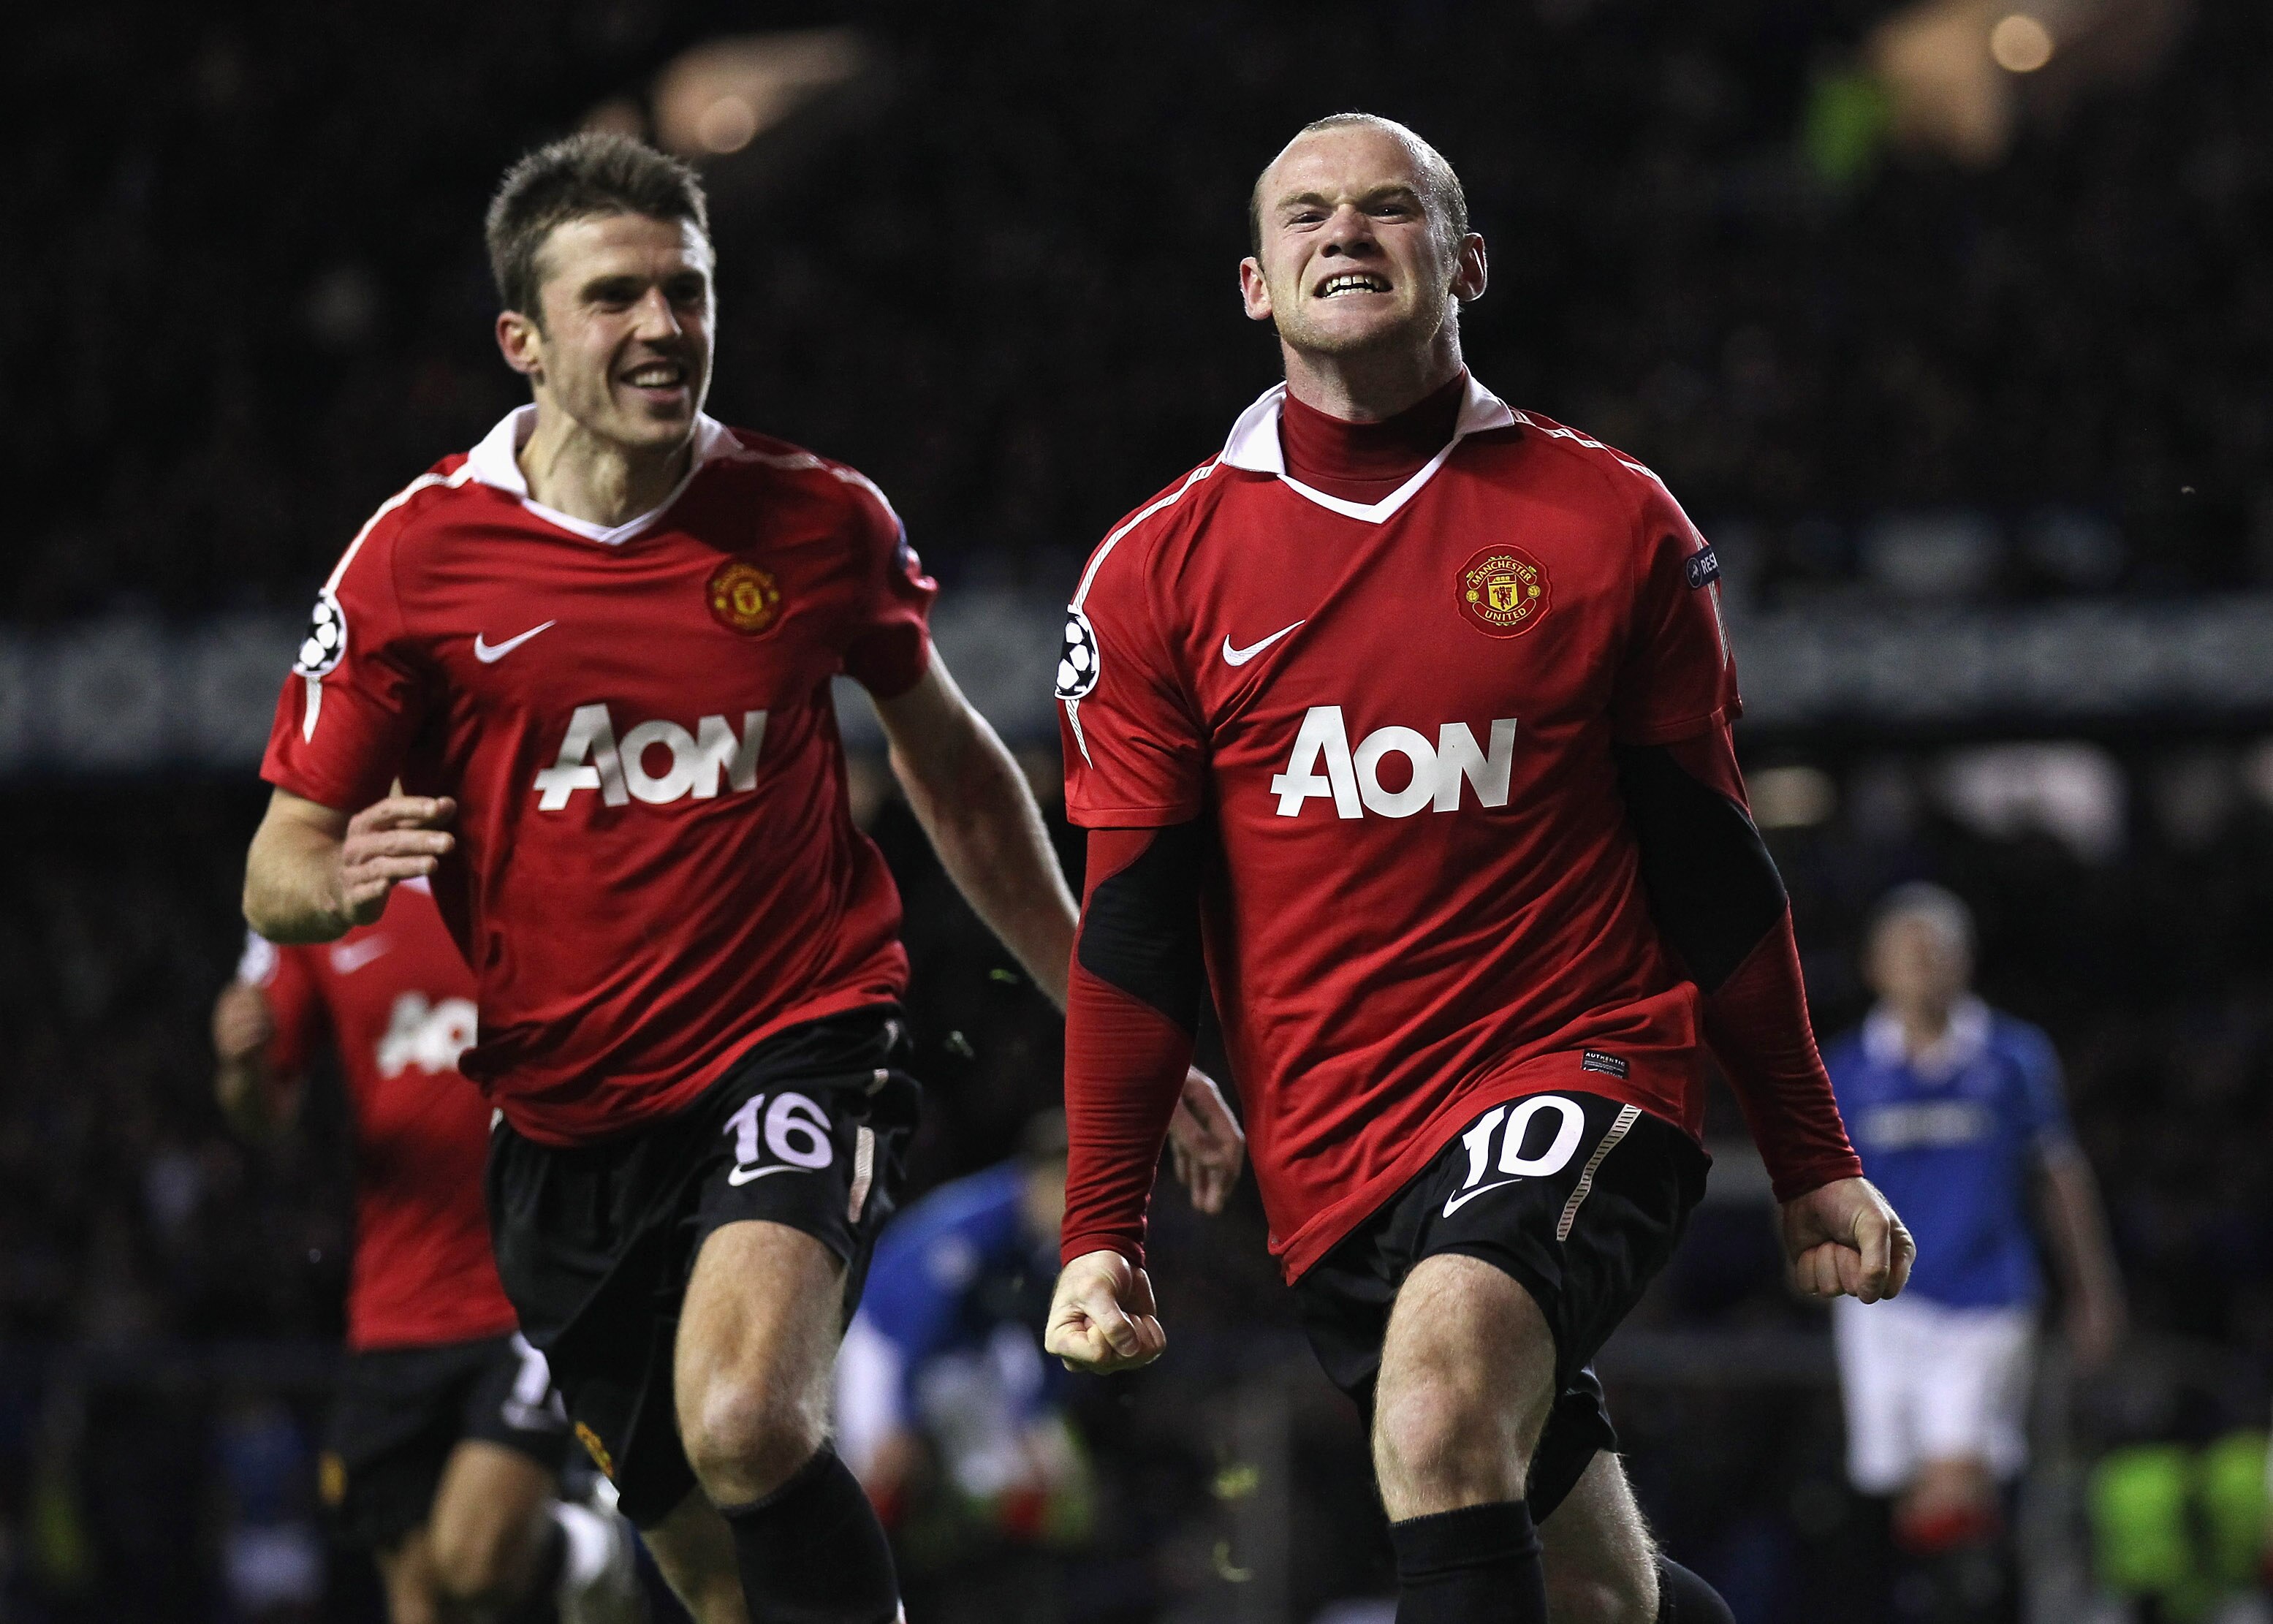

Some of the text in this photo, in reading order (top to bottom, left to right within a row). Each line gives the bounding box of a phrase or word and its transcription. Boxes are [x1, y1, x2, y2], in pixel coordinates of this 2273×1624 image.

[1471, 560, 1533, 586] MANCHESTER
[1484, 607, 1528, 621] UNITED
[533, 702, 769, 812] AON
[1270, 705, 1518, 819] AON
[1585, 1052, 1626, 1067] AUTHENTIC
[722, 1090, 833, 1169] 16
[1461, 1095, 1585, 1191] 10
